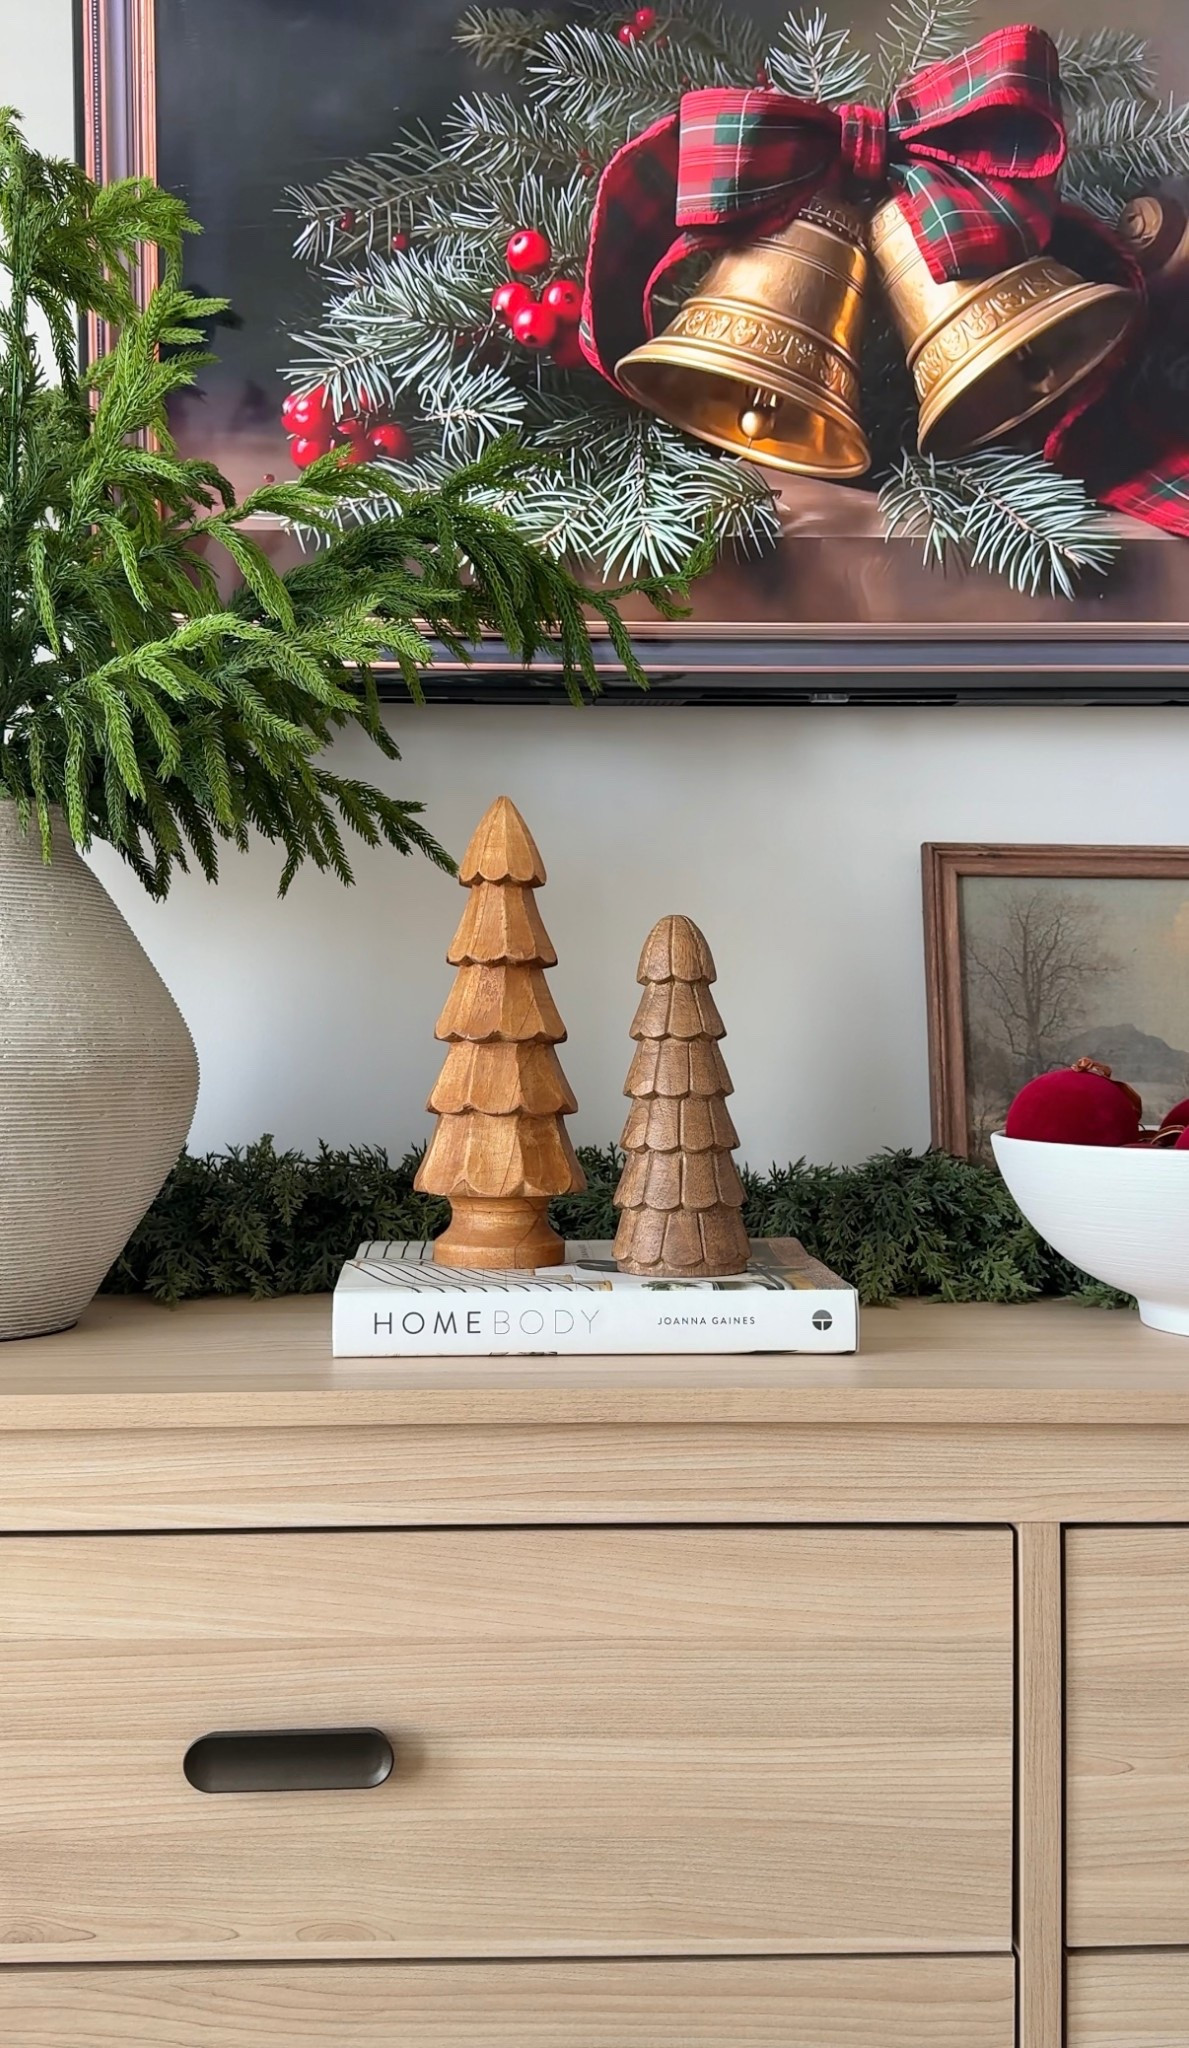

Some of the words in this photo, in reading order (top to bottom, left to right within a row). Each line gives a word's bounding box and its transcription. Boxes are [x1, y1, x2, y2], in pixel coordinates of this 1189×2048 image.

[373, 1309, 601, 1336] HOMEBODY
[657, 1316, 707, 1326] JOANNA
[711, 1316, 756, 1326] GAINES
